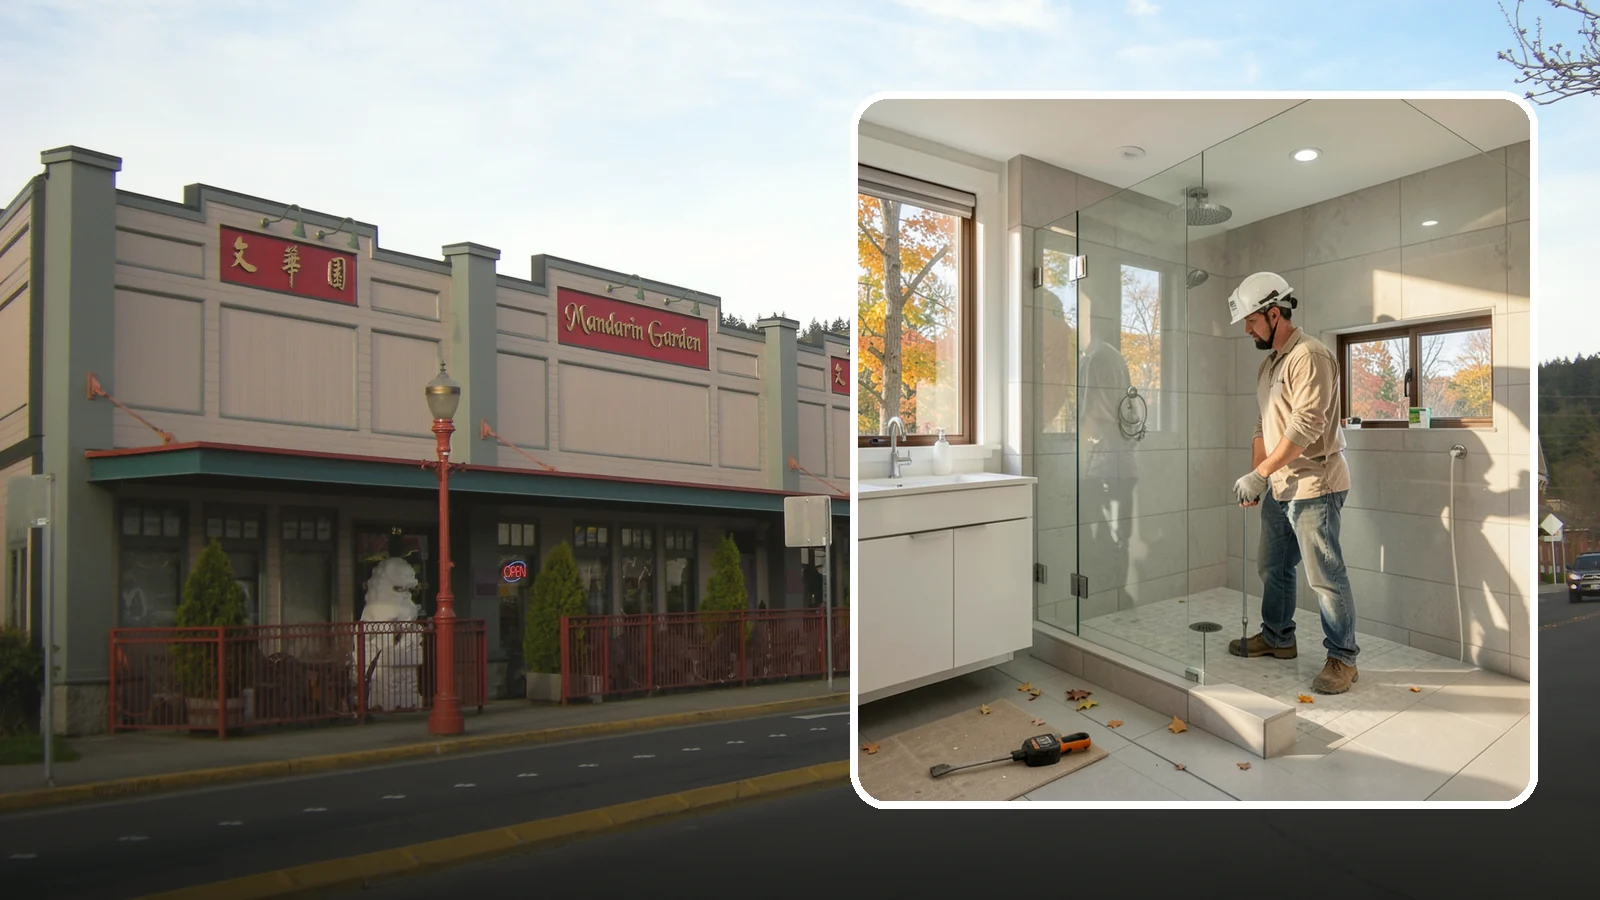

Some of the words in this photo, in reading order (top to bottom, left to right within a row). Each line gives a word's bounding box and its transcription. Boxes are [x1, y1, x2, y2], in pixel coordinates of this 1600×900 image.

[231, 235, 346, 291] 文華園
[564, 302, 644, 341] Mandarin
[647, 320, 702, 352] Garden
[503, 565, 527, 578] OPEN
